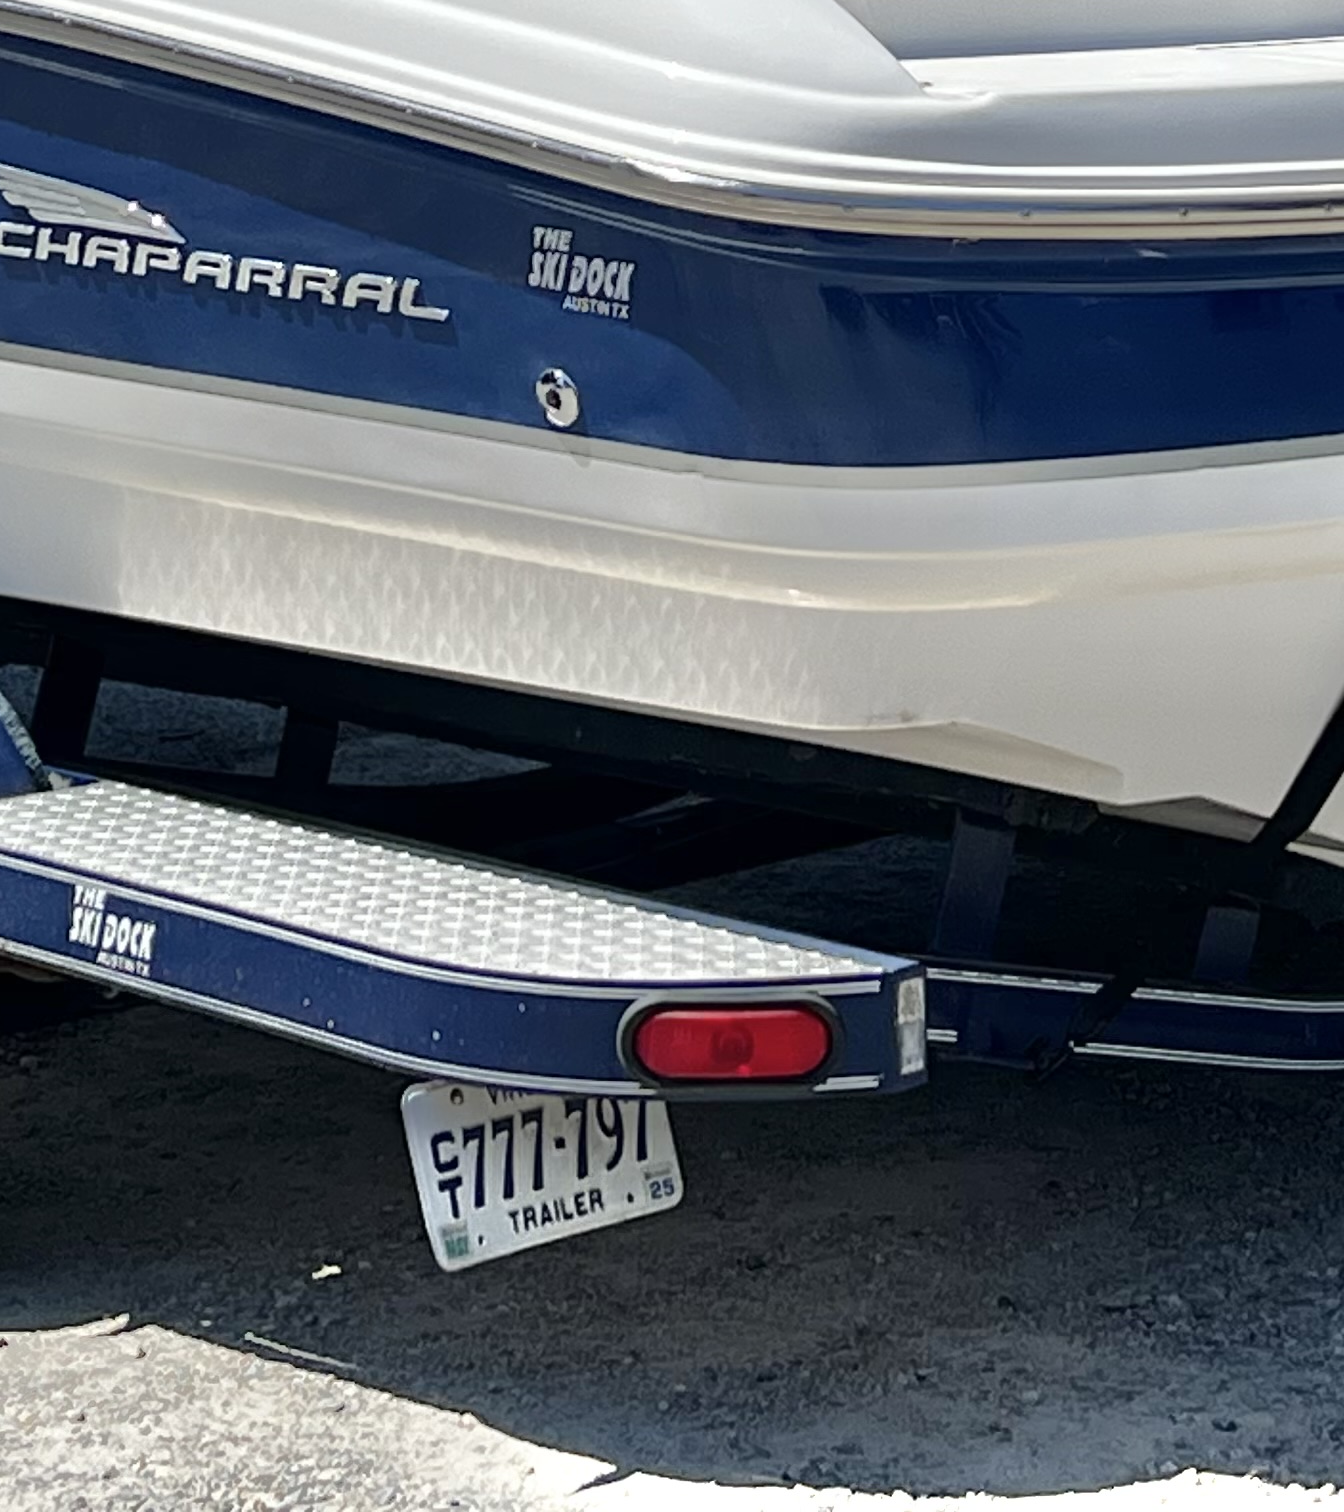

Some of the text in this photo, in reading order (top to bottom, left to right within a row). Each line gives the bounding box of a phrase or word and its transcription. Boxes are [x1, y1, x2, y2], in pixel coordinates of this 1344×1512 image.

[532, 225, 574, 253] THE
[527, 251, 636, 302] SKI DOCK
[72, 885, 107, 911] THE
[68, 906, 156, 961] SKI DOCK
[648, 1176, 675, 1200] 25
[507, 1188, 606, 1235] TRAILER
